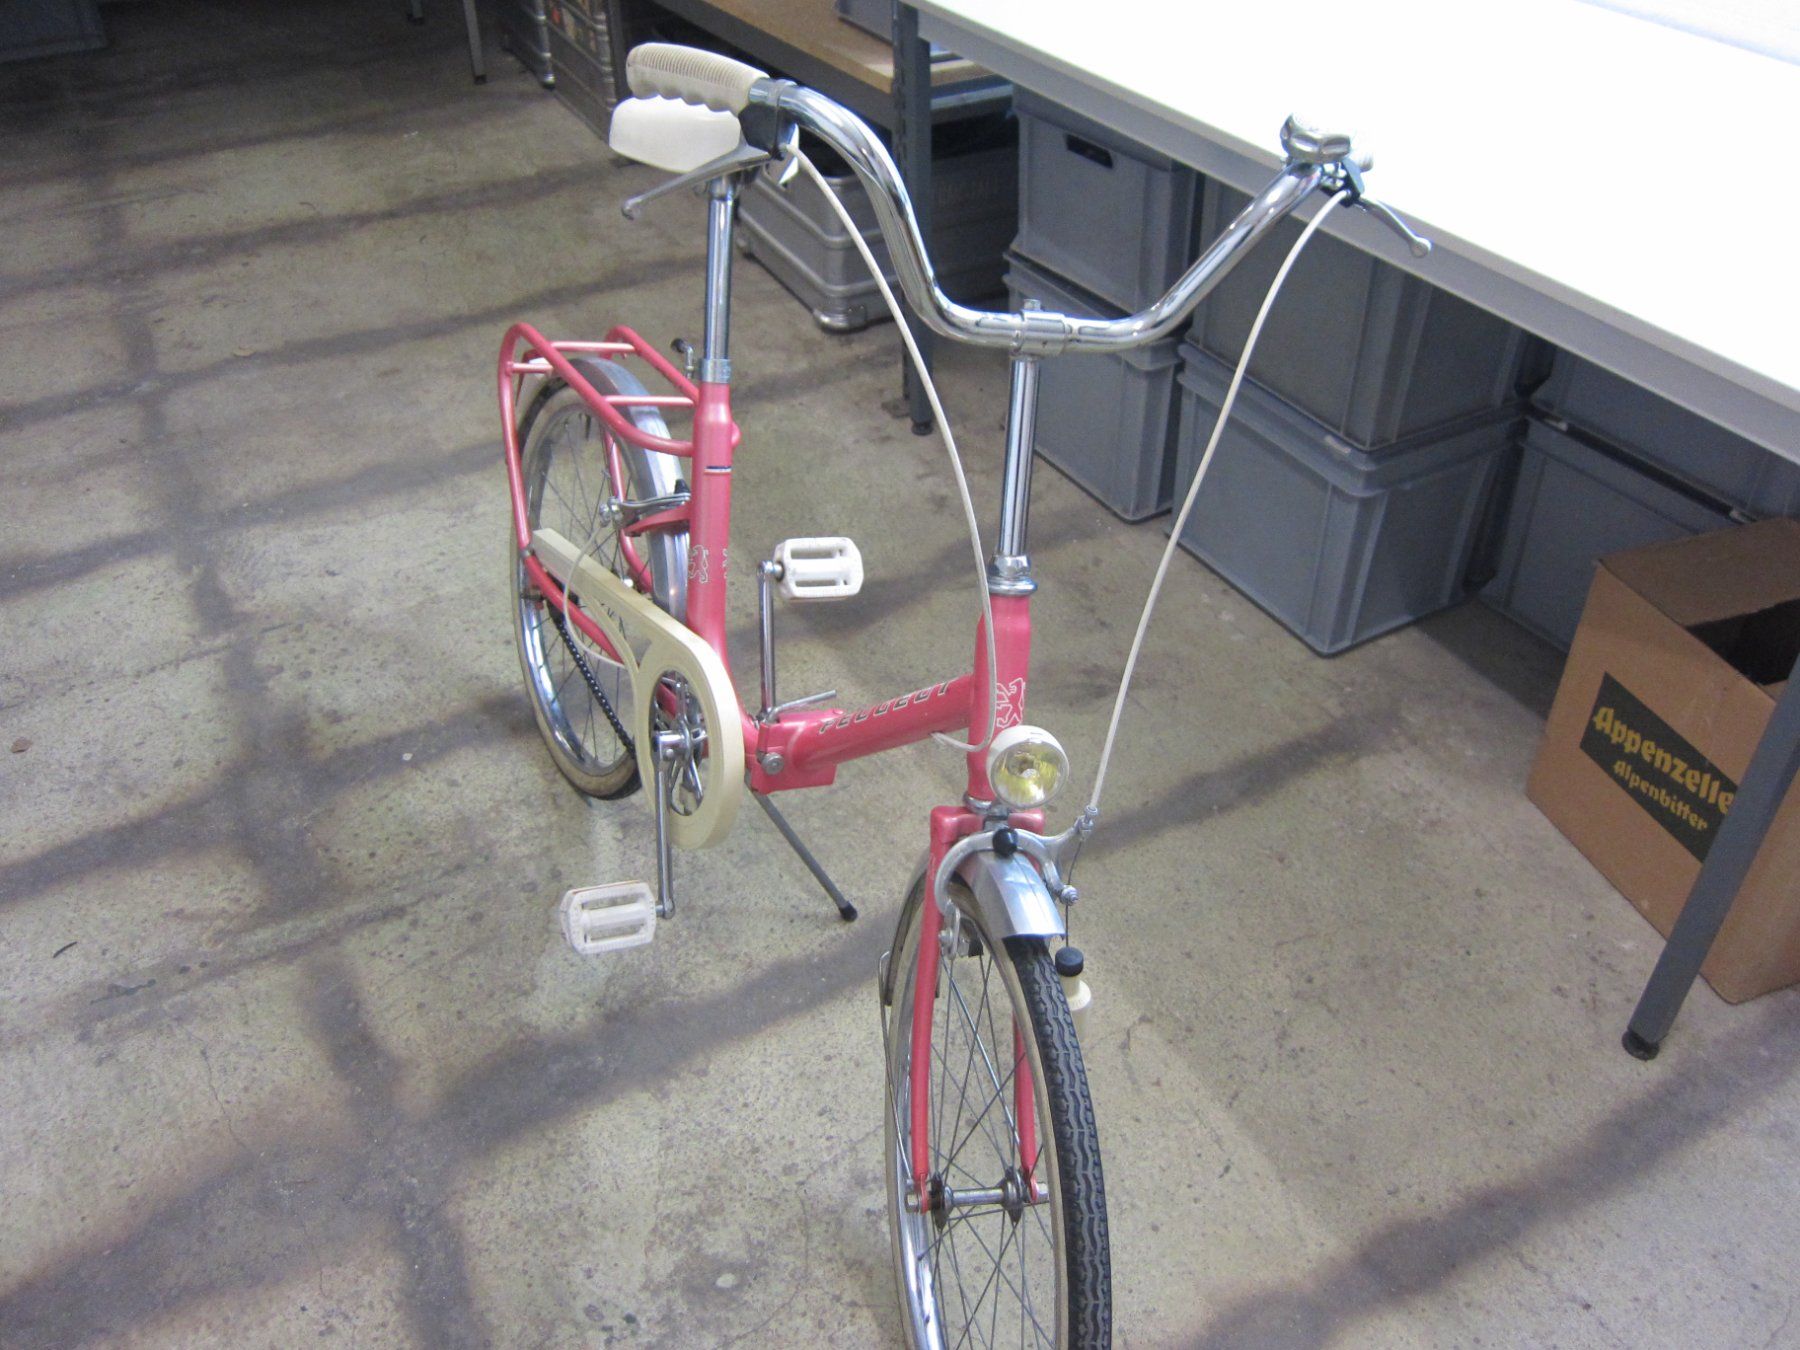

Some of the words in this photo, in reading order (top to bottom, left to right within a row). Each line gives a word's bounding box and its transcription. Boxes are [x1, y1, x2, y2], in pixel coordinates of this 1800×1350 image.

[820, 683, 948, 734] PEUGEOT
[1594, 707, 1735, 814] Appenzelle
[1614, 760, 1707, 831] Alpenbitter
